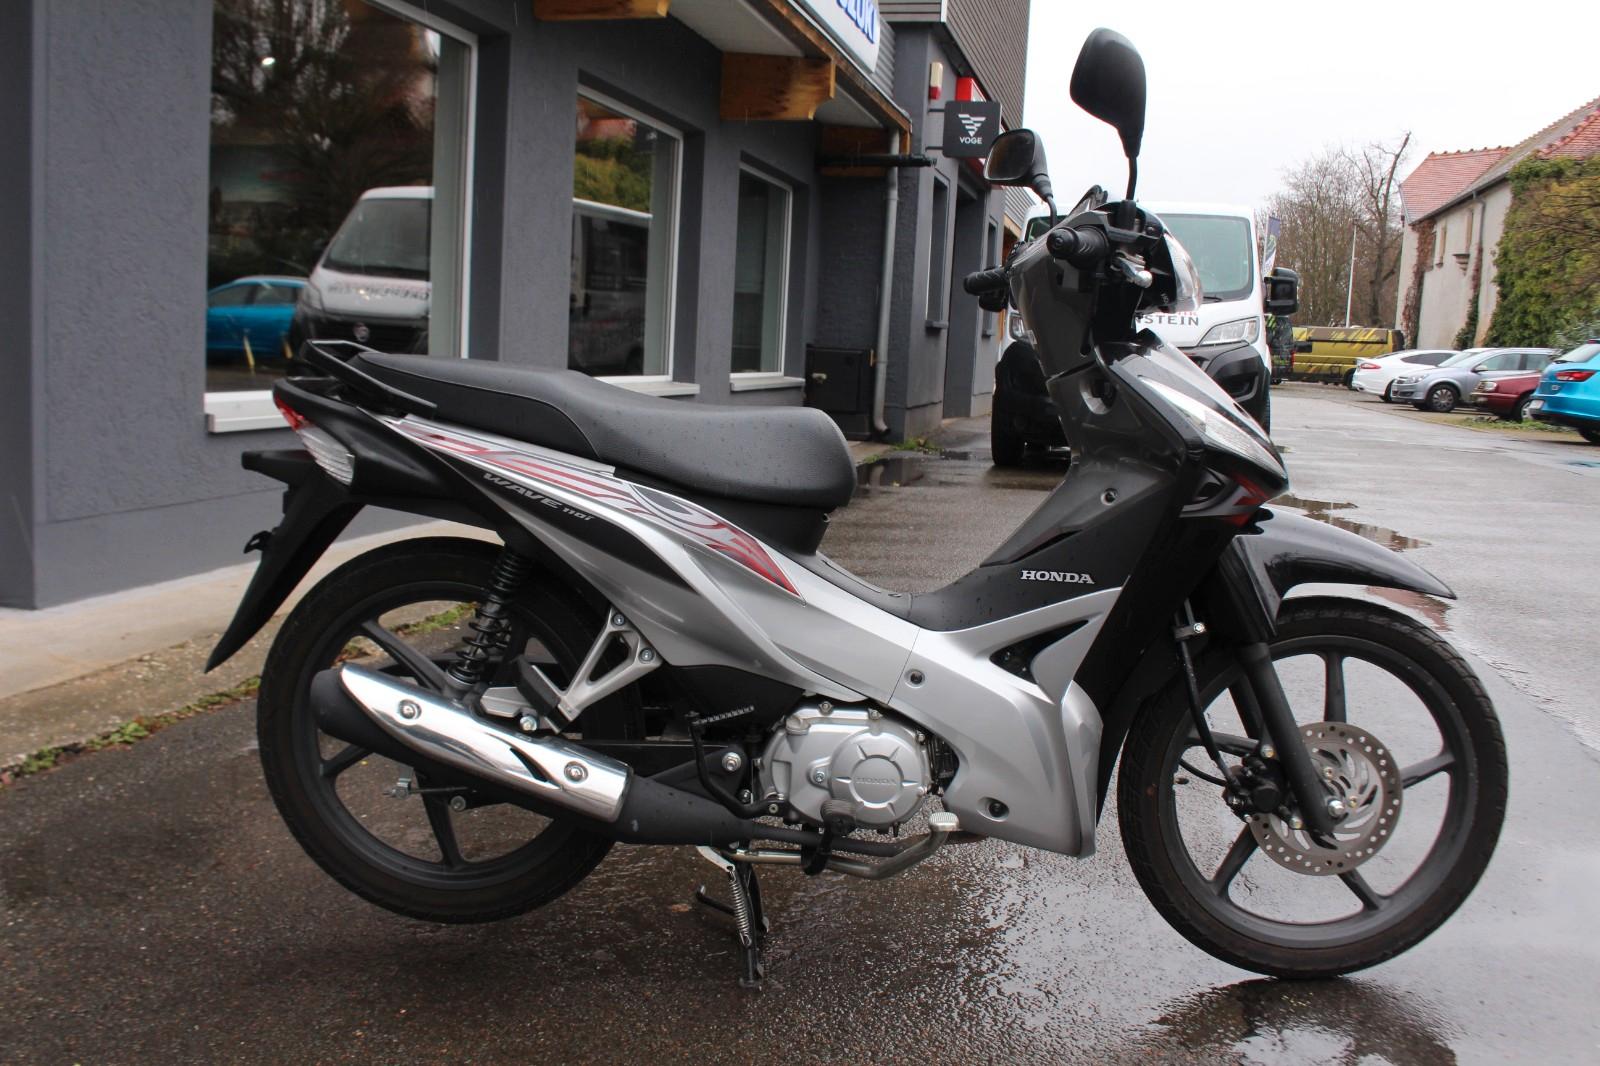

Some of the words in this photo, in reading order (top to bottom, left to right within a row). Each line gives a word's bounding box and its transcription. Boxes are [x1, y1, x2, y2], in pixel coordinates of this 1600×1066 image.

[959, 136, 983, 145] VOGE
[483, 473, 562, 509] WAVE
[563, 508, 595, 521] 110i
[1020, 570, 1095, 585] HONDA
[855, 777, 897, 785] HONDA
